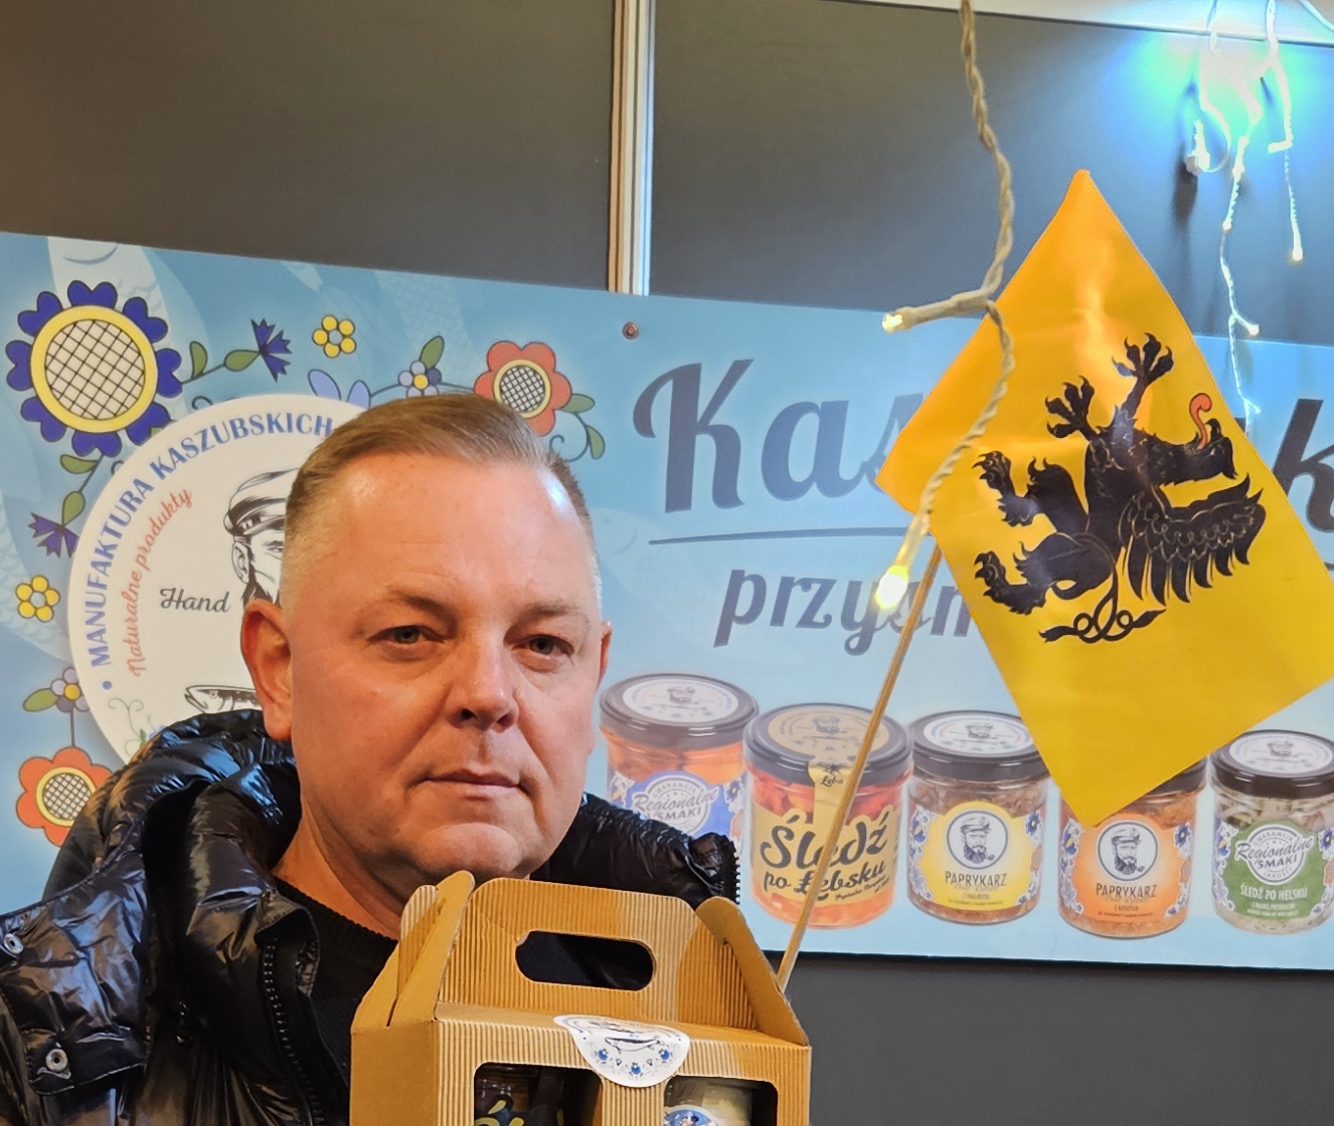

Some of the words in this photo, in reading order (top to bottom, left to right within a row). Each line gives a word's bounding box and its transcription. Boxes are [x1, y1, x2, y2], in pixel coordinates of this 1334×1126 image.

[85, 478, 155, 667] MANUFAKTURA
[149, 412, 334, 481] KASZUBSKICH
[121, 568, 146, 677] Naturalne
[137, 488, 192, 572] produkty
[159, 587, 231, 613] Hand
[657, 806, 702, 822] SMAKI
[1236, 837, 1314, 860] Regionalne
[1256, 855, 1298, 870] SMAKI
[764, 871, 792, 892] po
[945, 871, 1008, 888] PAPRYKARZ
[1095, 883, 1158, 899] PAPRYKARZ
[1240, 884, 1264, 901] ŚLEDŹ
[1266, 886, 1277, 901] PO
[1278, 887, 1308, 899] HELSKU
